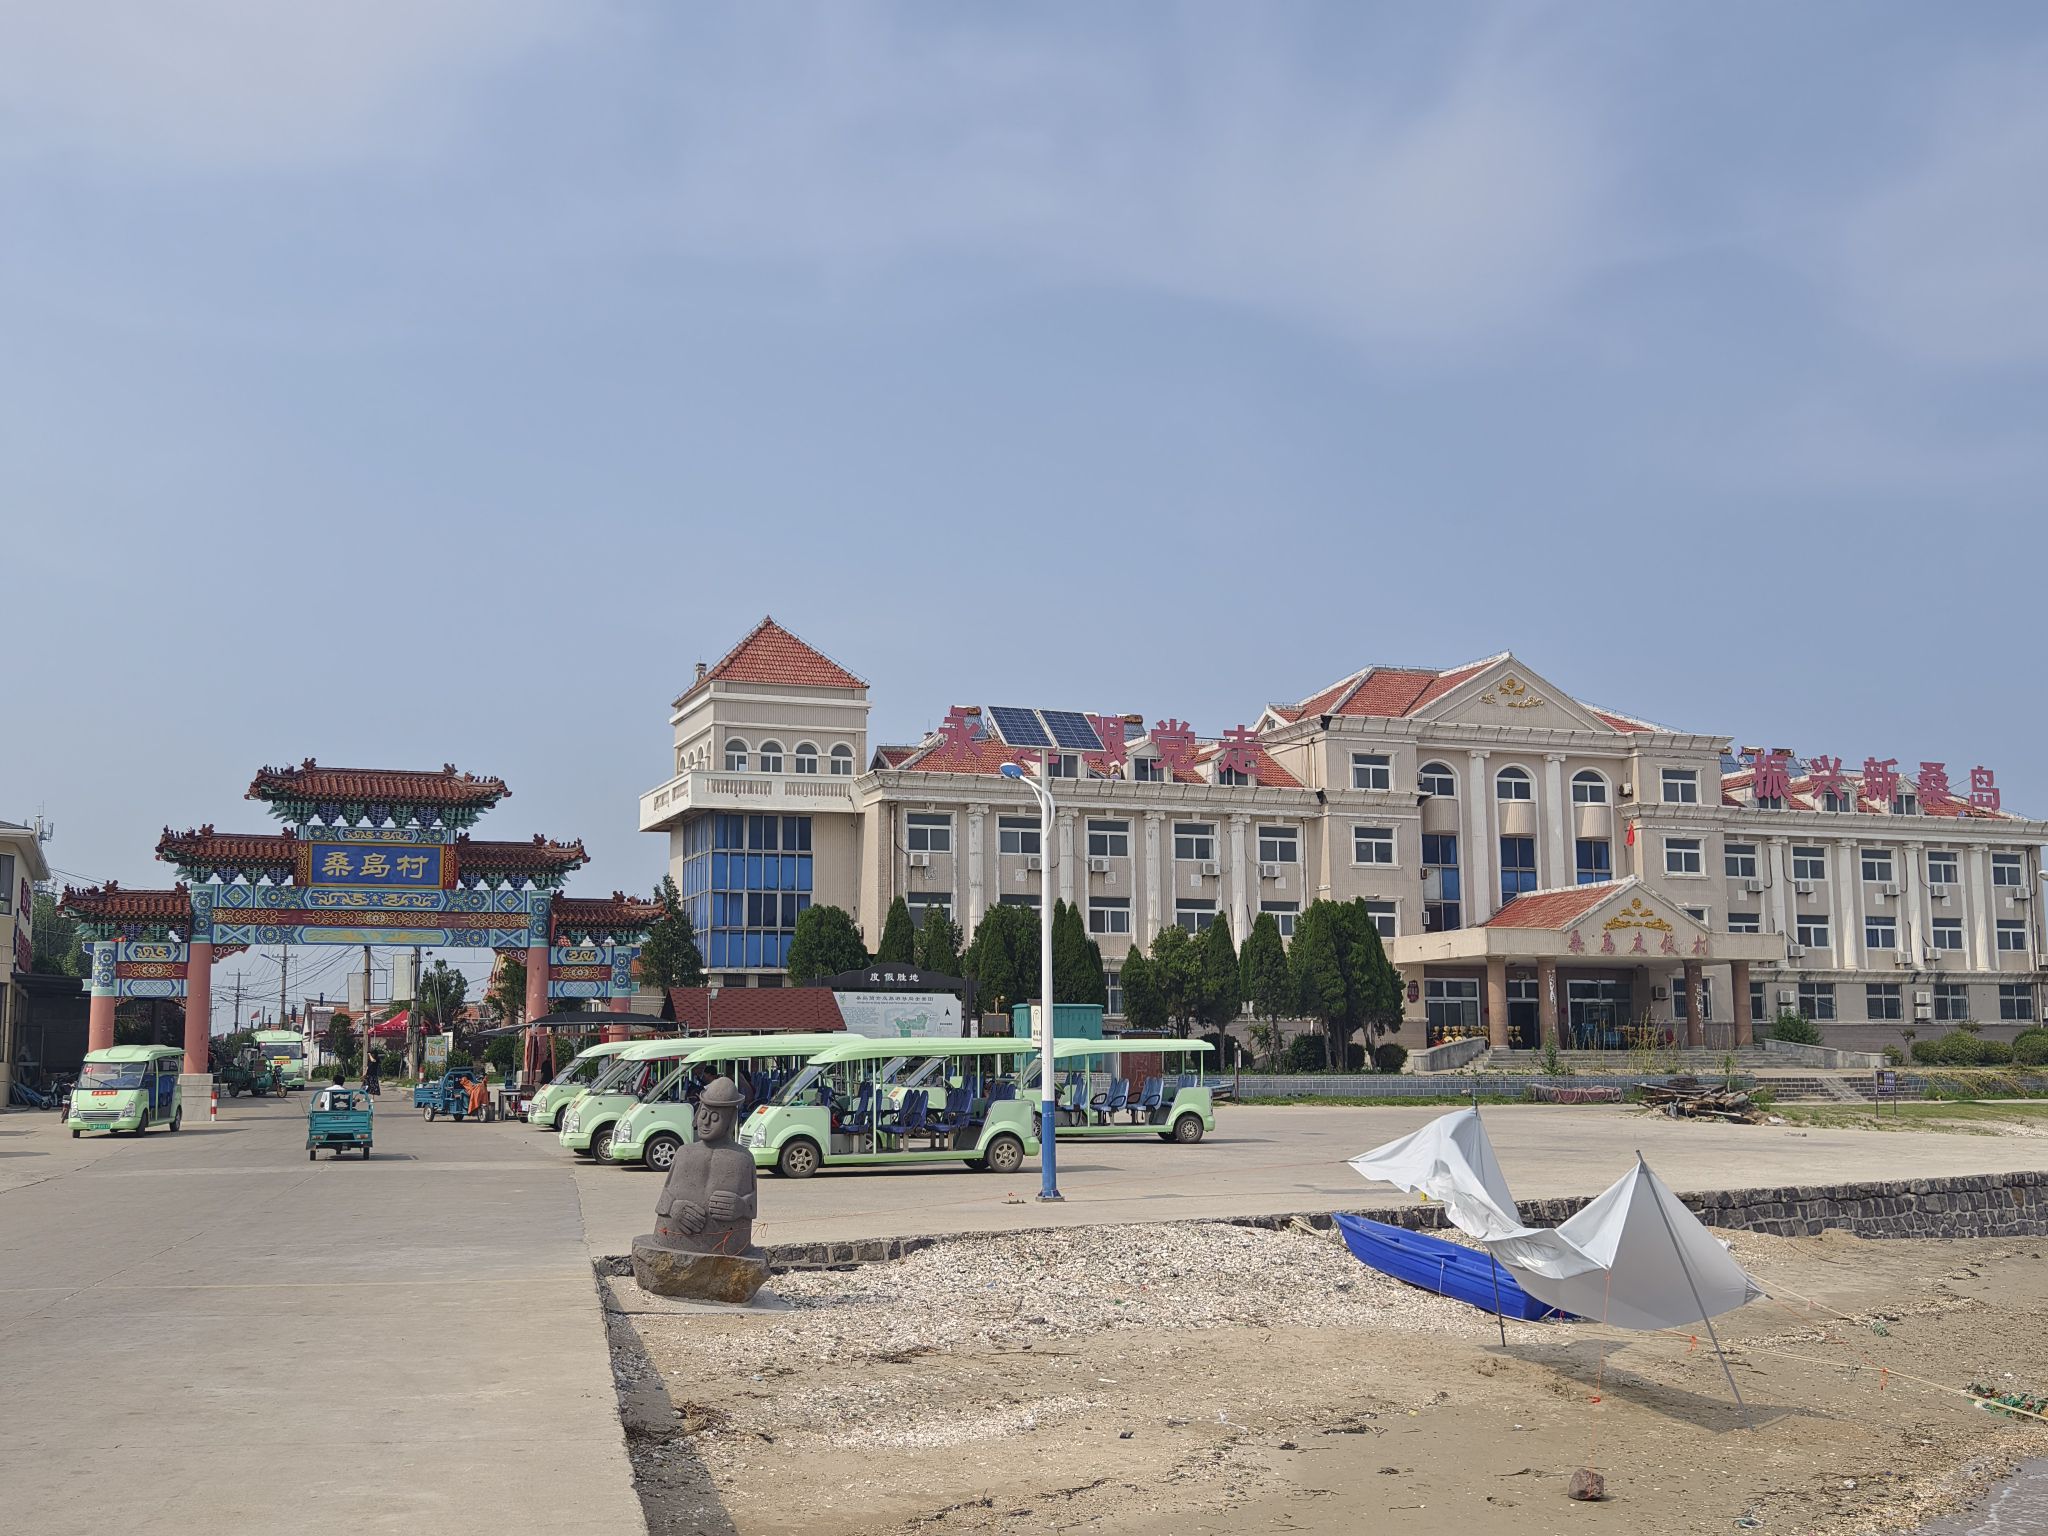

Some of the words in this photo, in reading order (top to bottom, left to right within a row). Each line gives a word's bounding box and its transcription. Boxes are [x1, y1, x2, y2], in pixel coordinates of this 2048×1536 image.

[938, 705, 1264, 775] 永跟党走
[1750, 753, 2001, 811] 振兴新桑岛
[321, 851, 430, 879] 桑岛村
[1568, 929, 1709, 955] 桑岛度假村
[869, 972, 920, 982] 度假胜地
